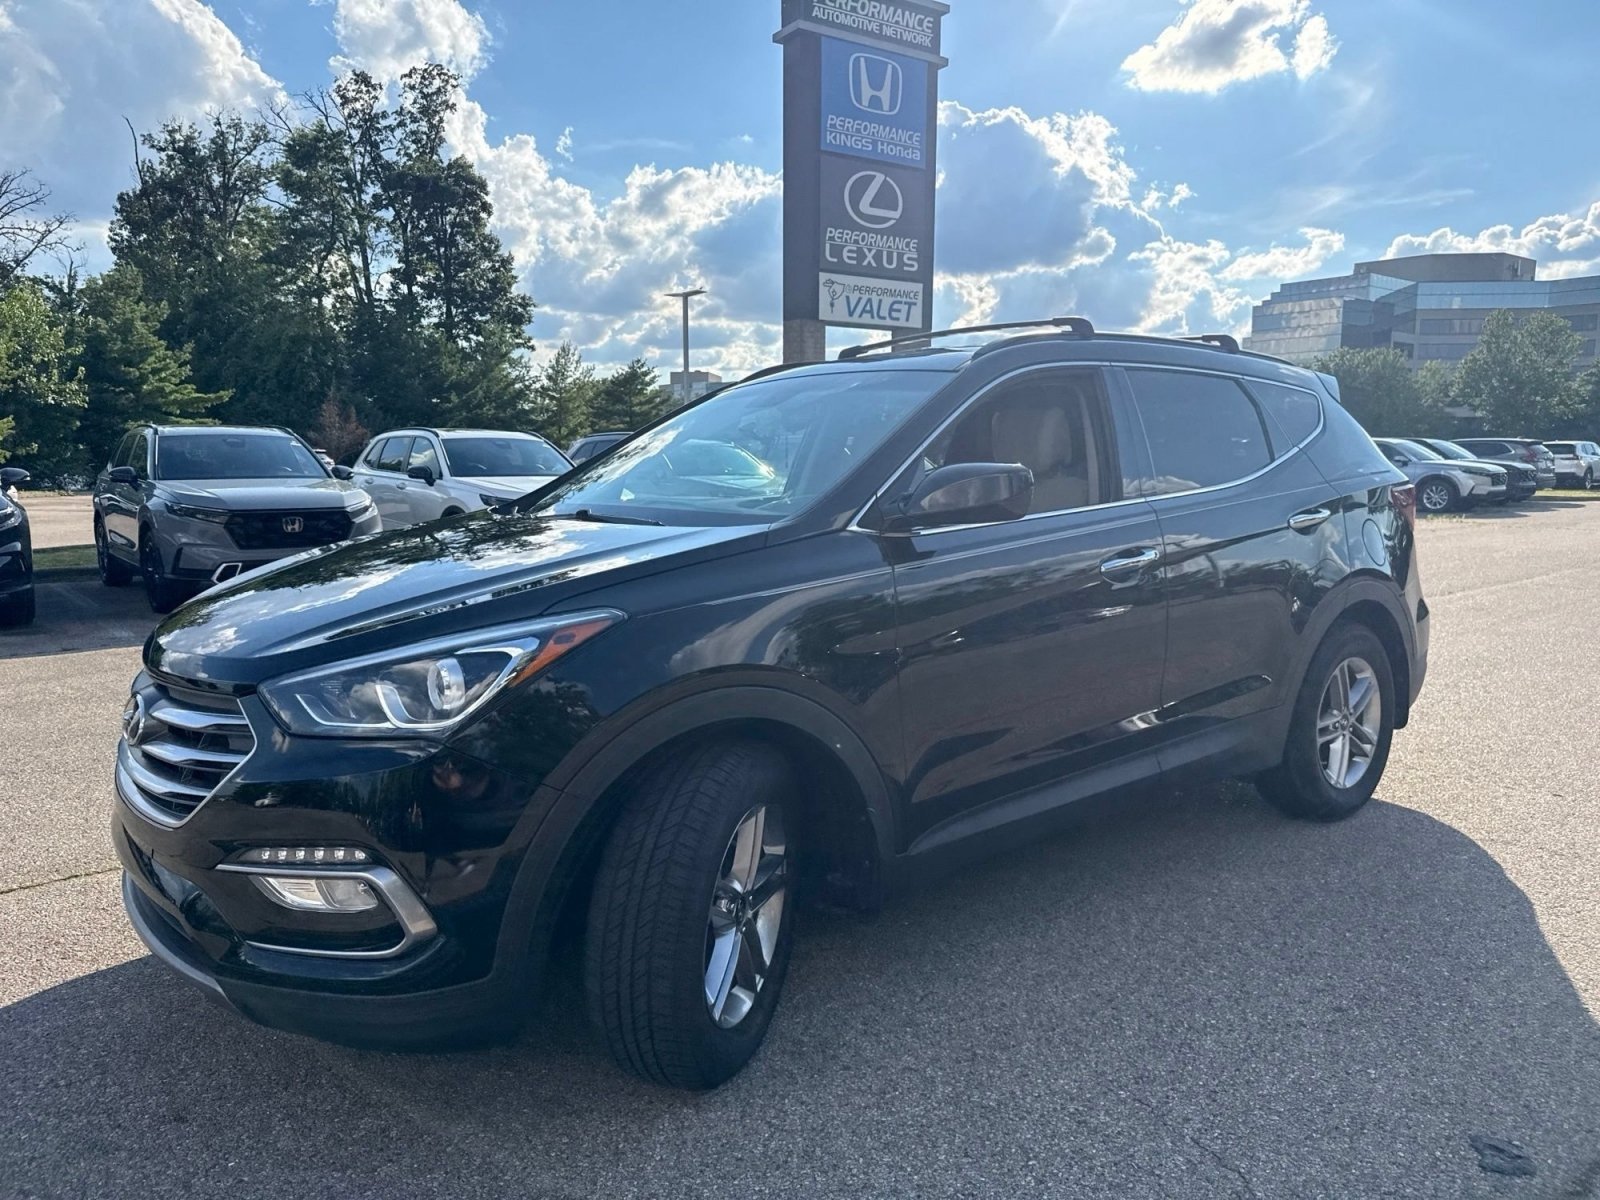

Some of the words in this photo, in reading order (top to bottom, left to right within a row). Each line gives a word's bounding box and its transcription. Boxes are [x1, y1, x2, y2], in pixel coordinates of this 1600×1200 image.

[812, 6, 880, 34] AUTOMOTIVE
[882, 24, 932, 47] NETWORK
[813, 0, 933, 33] RFORMANCE
[826, 115, 921, 145] PERFORMANCE
[826, 132, 873, 151] KINGS
[877, 141, 921, 160] Honda
[825, 227, 918, 252] PERFORMANCE
[825, 243, 919, 271] LEXUS
[852, 284, 919, 300] PERFORMANCE
[845, 295, 917, 322] VALET
